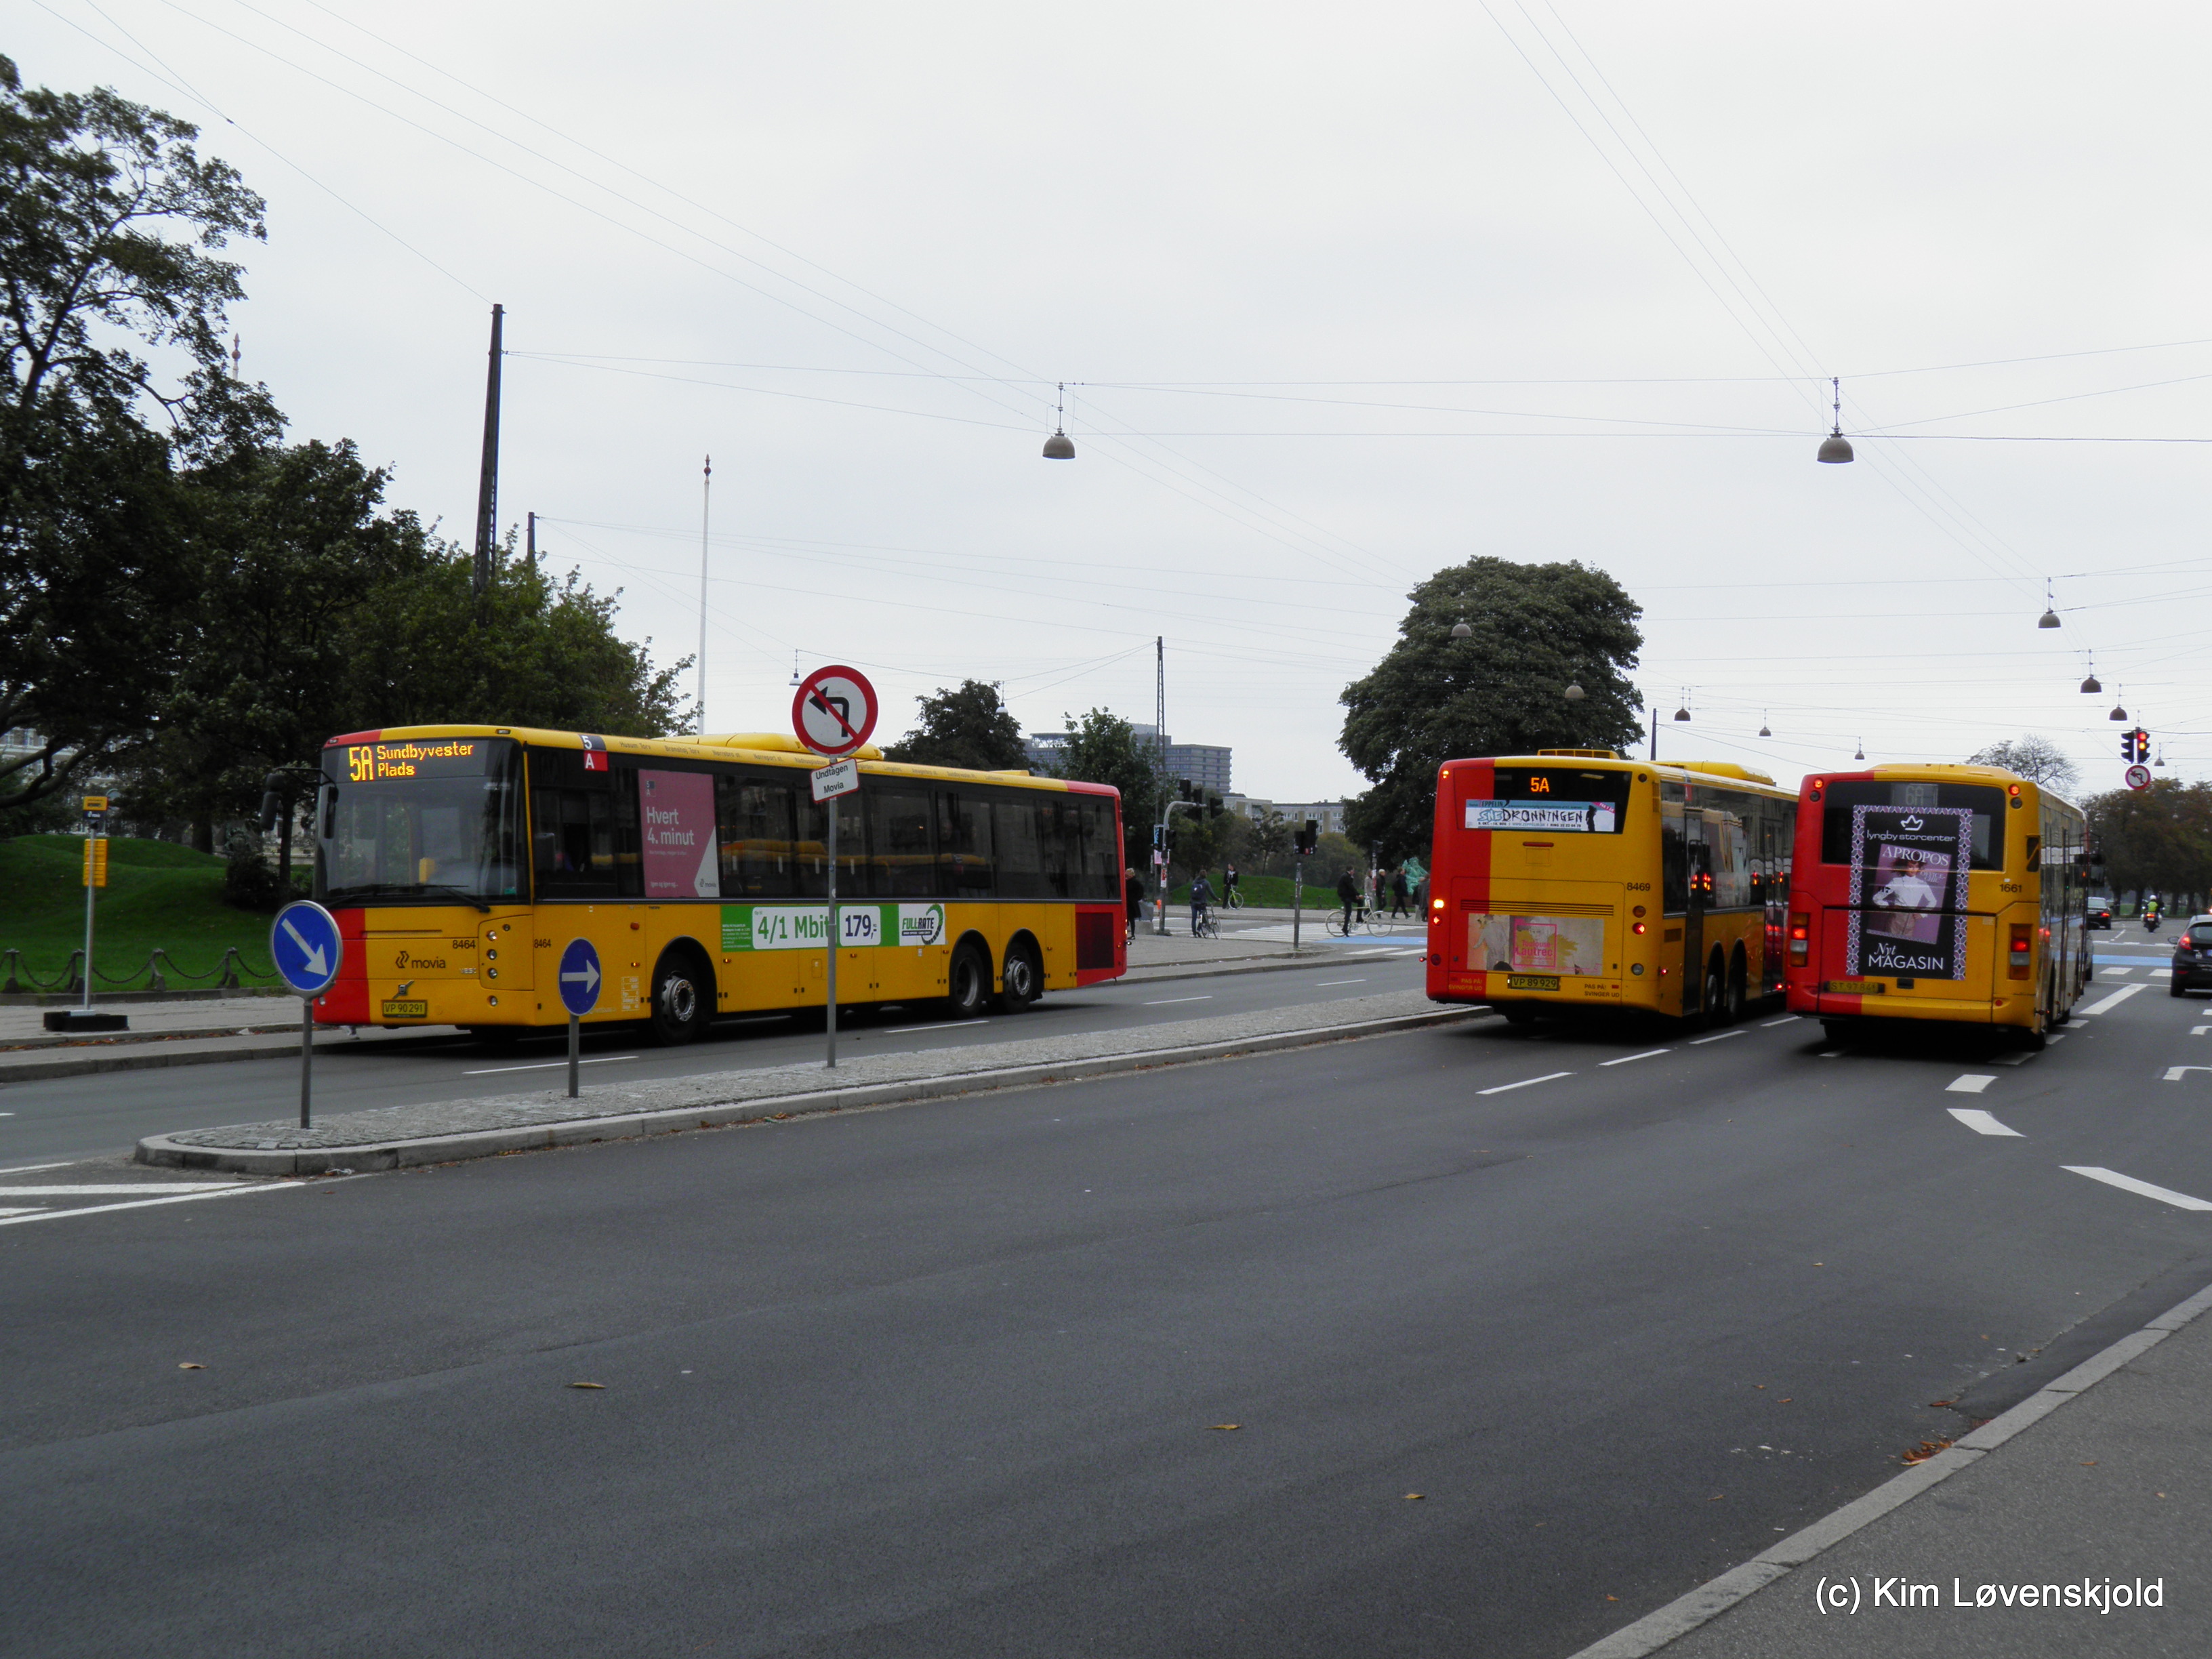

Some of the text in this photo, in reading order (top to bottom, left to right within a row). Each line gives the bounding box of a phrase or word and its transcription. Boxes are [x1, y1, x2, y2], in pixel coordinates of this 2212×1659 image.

[581, 735, 592, 750] 5
[377, 741, 474, 761] Sundbyvester
[348, 746, 373, 781] 5A
[585, 753, 594, 769] A
[377, 762, 415, 777] Plads
[816, 765, 848, 779] Undtagen
[823, 781, 844, 794] Movia
[1530, 777, 1550, 792] 5A
[1906, 785, 1924, 805] 6A
[646, 806, 679, 824] Hvert
[647, 827, 695, 845] 4. minut
[1867, 830, 1956, 842] lyngby storcenter
[1883, 846, 1948, 866] APROPOS
[1626, 882, 1650, 891] 8469
[1999, 884, 2022, 893] 1661
[758, 915, 787, 944] 4/1
[902, 918, 935, 929] FULLRATE
[453, 939, 476, 949] 8464
[534, 939, 551, 948] 8464
[1874, 943, 1896, 958] Nyt
[1515, 946, 1553, 957] Lautrec
[411, 956, 446, 968] movia
[1868, 954, 1944, 970] MAGASIN
[1513, 977, 1525, 986] VP
[385, 1003, 396, 1012] VP
